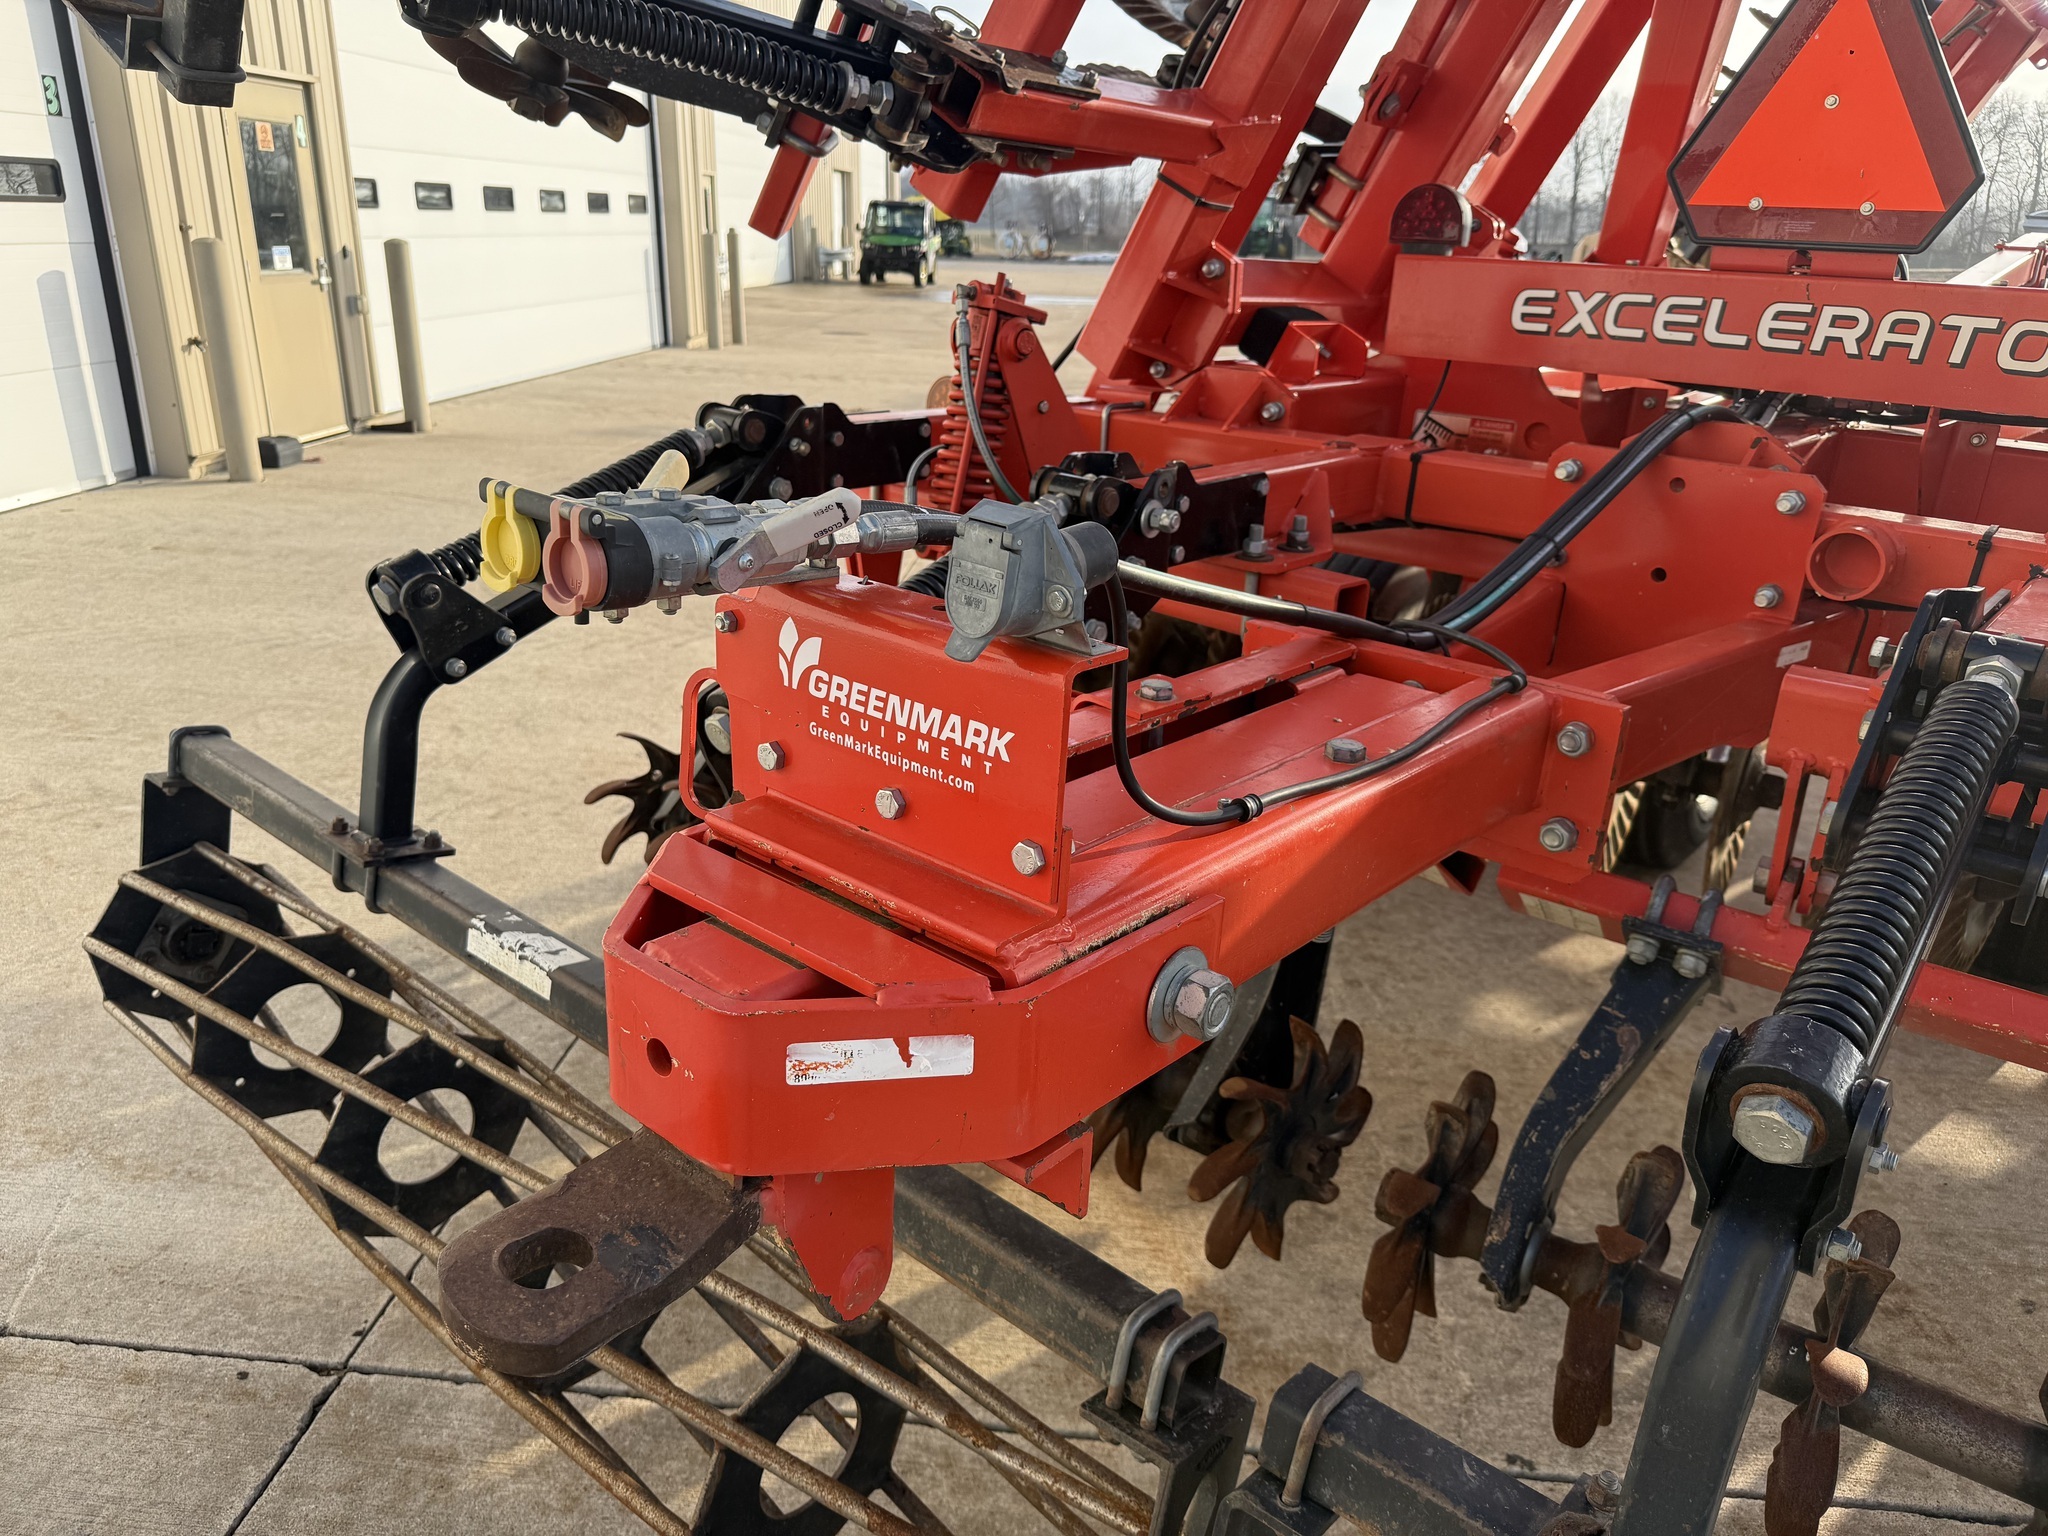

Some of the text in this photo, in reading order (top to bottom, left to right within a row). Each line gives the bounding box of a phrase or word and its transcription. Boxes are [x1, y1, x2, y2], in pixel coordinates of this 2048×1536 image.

[43, 75, 60, 115] 3
[296, 114, 307, 148] 4
[813, 521, 843, 539] CLOSED
[808, 669, 1016, 763] GREENMARK
[821, 705, 993, 775] EQUIPMENT
[809, 722, 975, 794] GreenMarkEquipment.com
